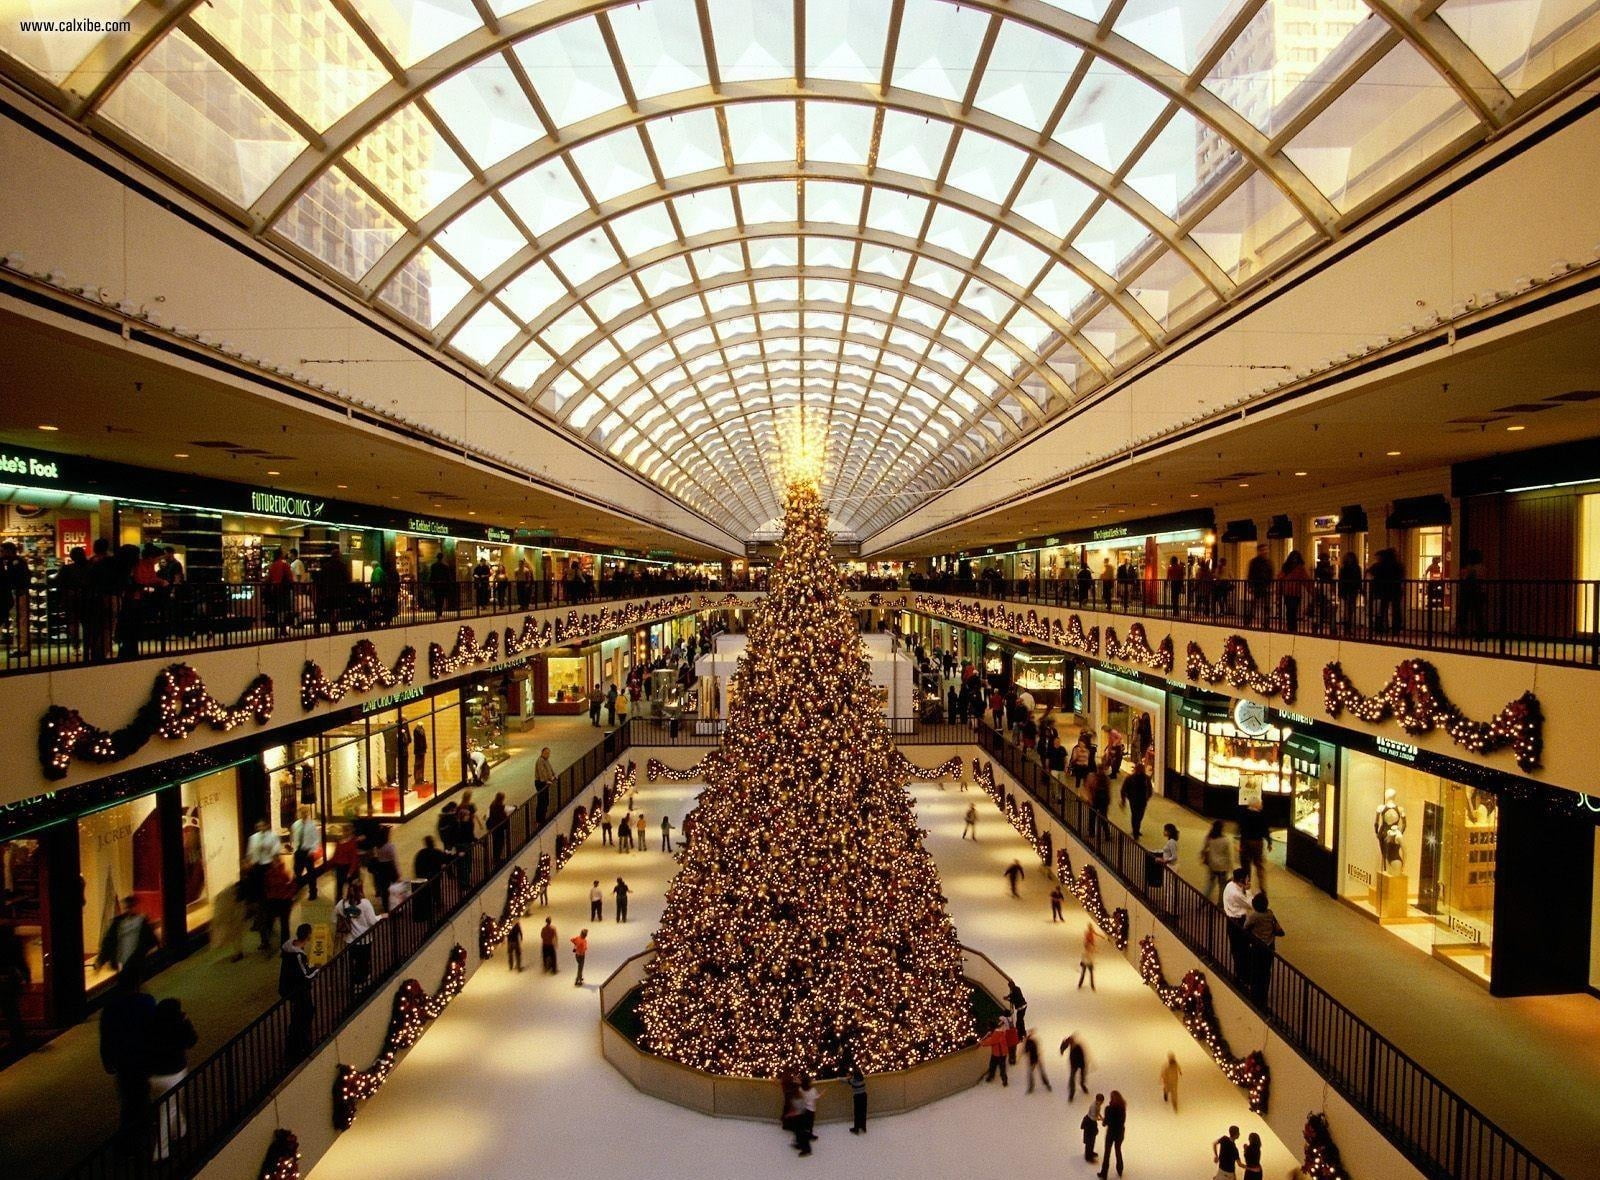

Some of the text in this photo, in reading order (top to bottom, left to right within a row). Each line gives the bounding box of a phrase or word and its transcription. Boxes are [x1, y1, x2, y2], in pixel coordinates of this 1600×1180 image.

[29, 458, 59, 479] Foot
[251, 491, 311, 517] FUTURETRONICS
[63, 531, 87, 543] BUY
